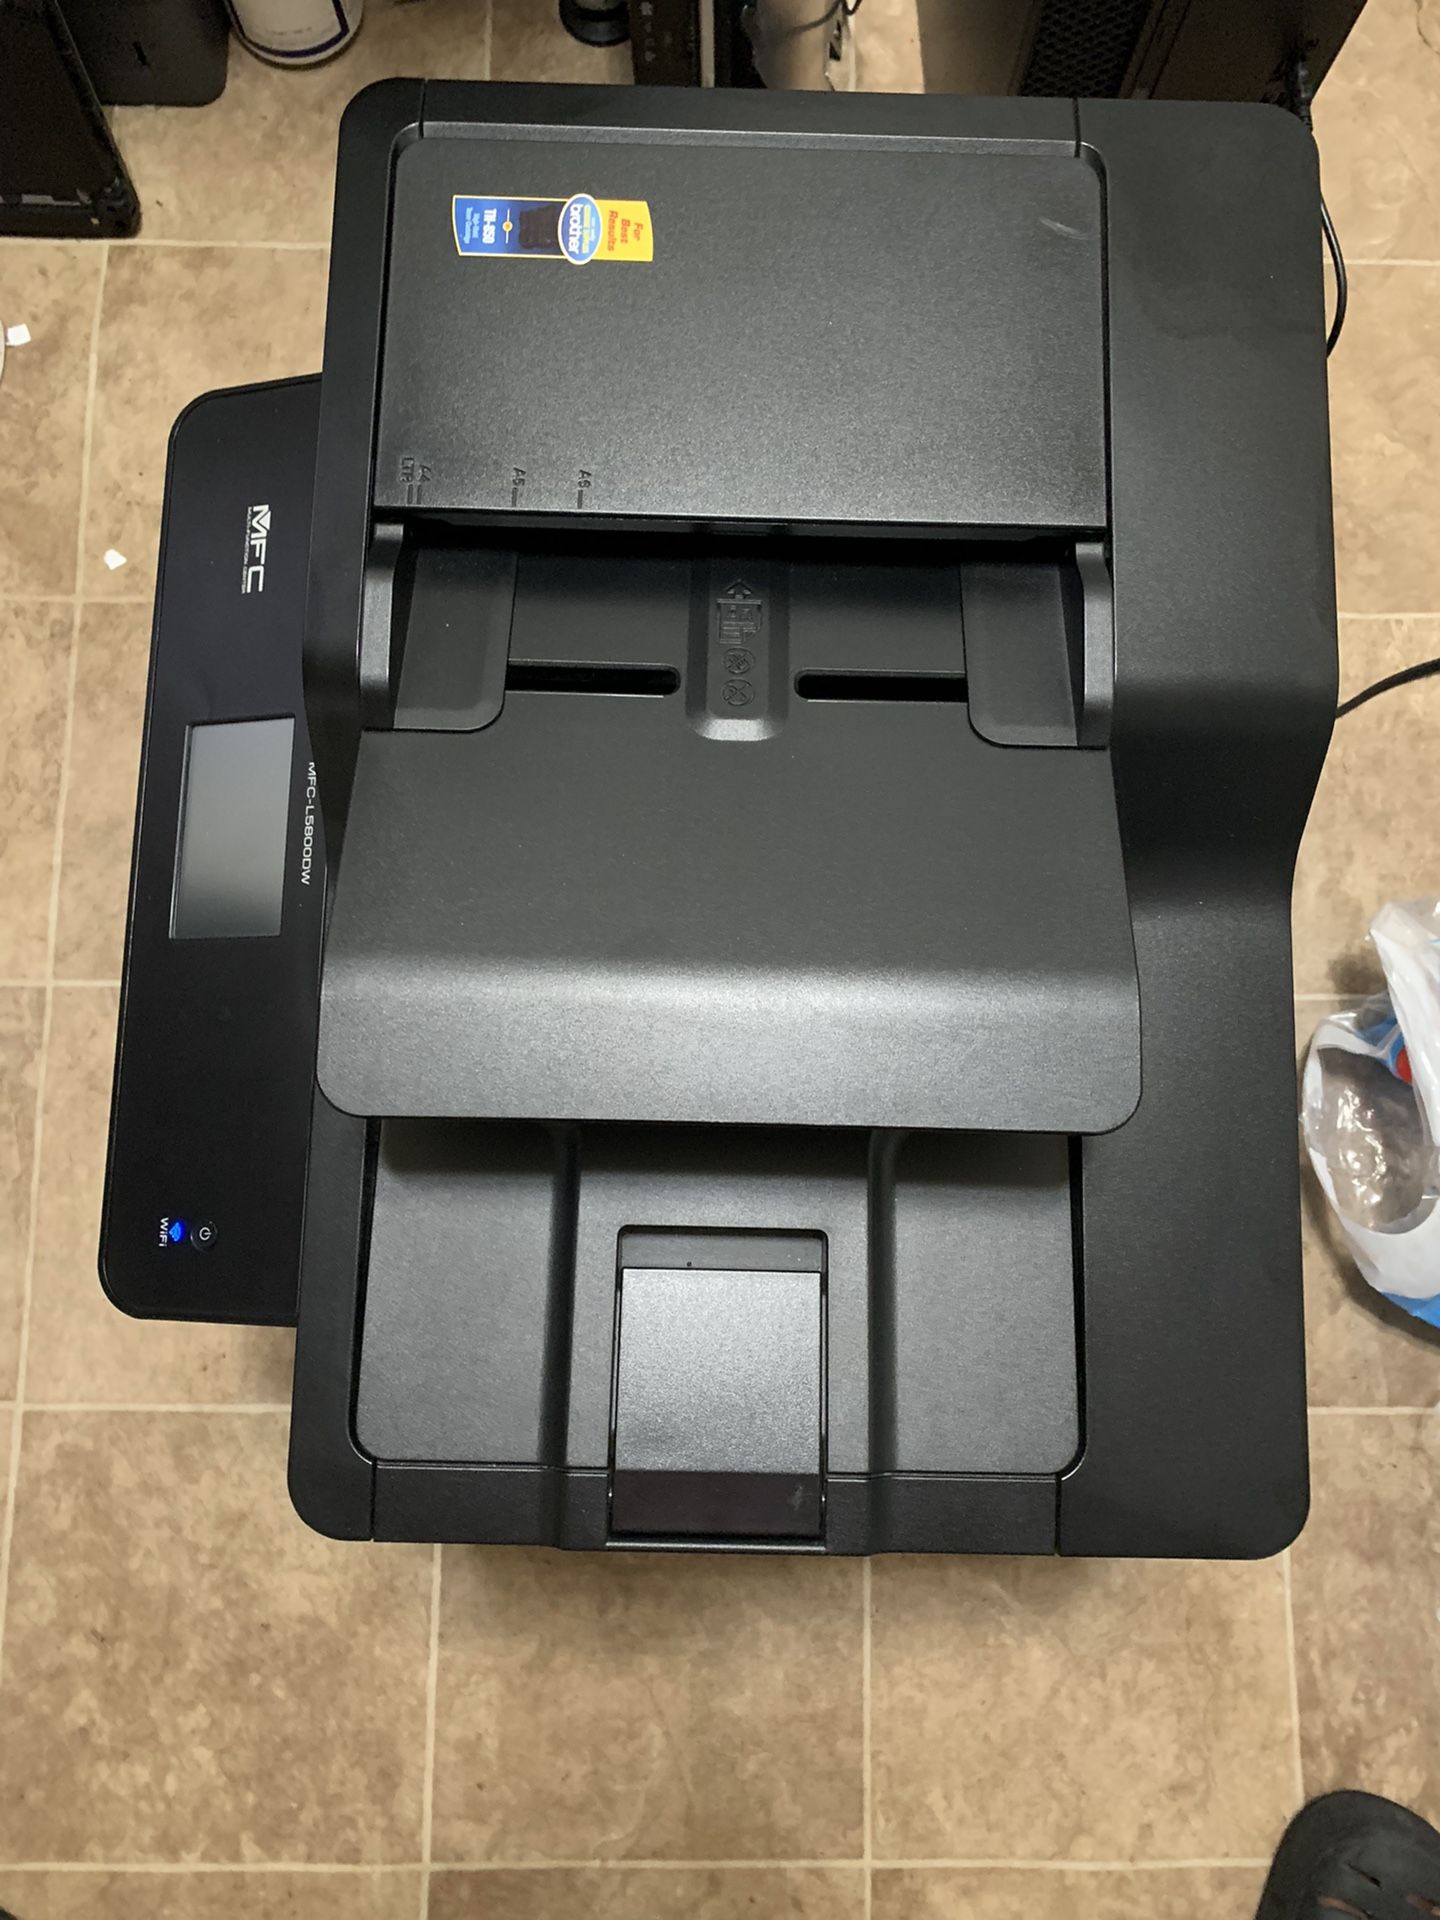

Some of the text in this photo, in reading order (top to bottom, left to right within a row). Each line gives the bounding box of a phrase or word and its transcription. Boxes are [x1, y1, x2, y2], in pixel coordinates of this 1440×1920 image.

[568, 203, 584, 254] brother
[607, 210, 618, 251] Results
[620, 218, 631, 244] Best
[633, 222, 644, 241] For
[416, 464, 431, 483] A4
[512, 467, 526, 486] A5
[577, 469, 592, 488] A6
[246, 504, 271, 593] MFC
[300, 761, 317, 885] MFC-L5800DW
